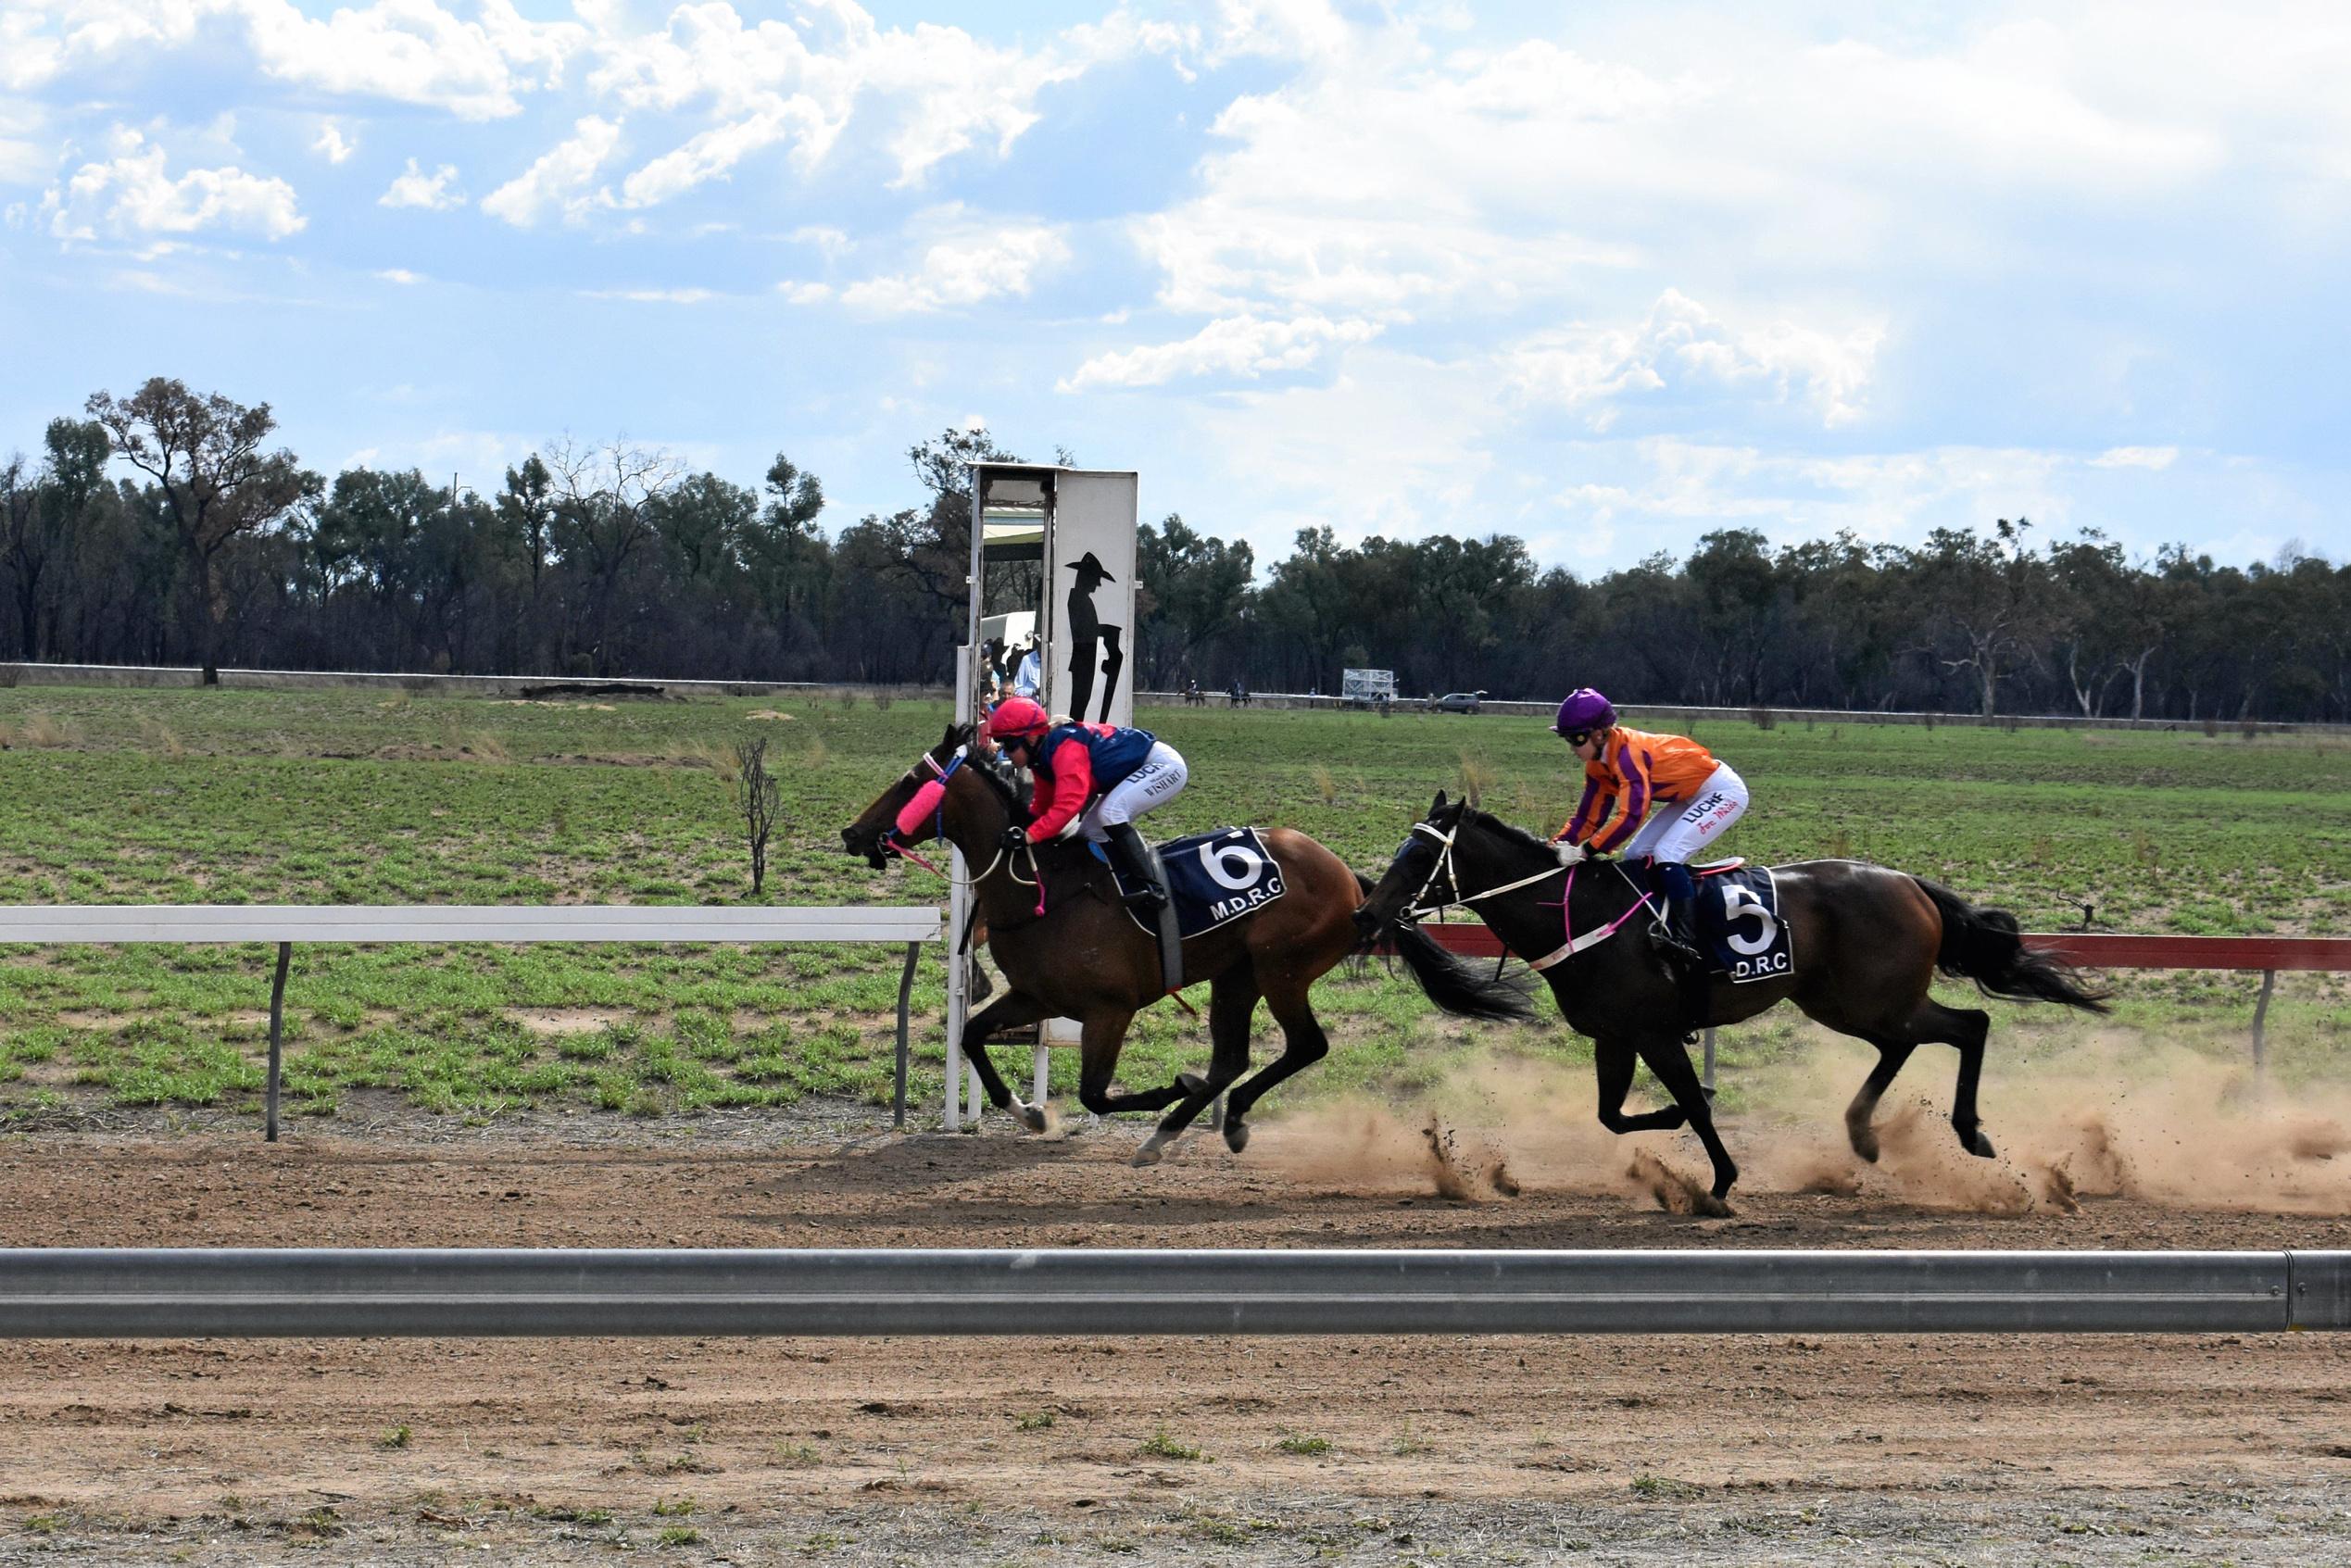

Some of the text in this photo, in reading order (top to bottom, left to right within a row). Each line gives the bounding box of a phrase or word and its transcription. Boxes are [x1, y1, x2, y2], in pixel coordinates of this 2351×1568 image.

[1144, 769, 1181, 797] WISHART
[1200, 831, 1263, 890] 6
[1721, 884, 1778, 955] 5
